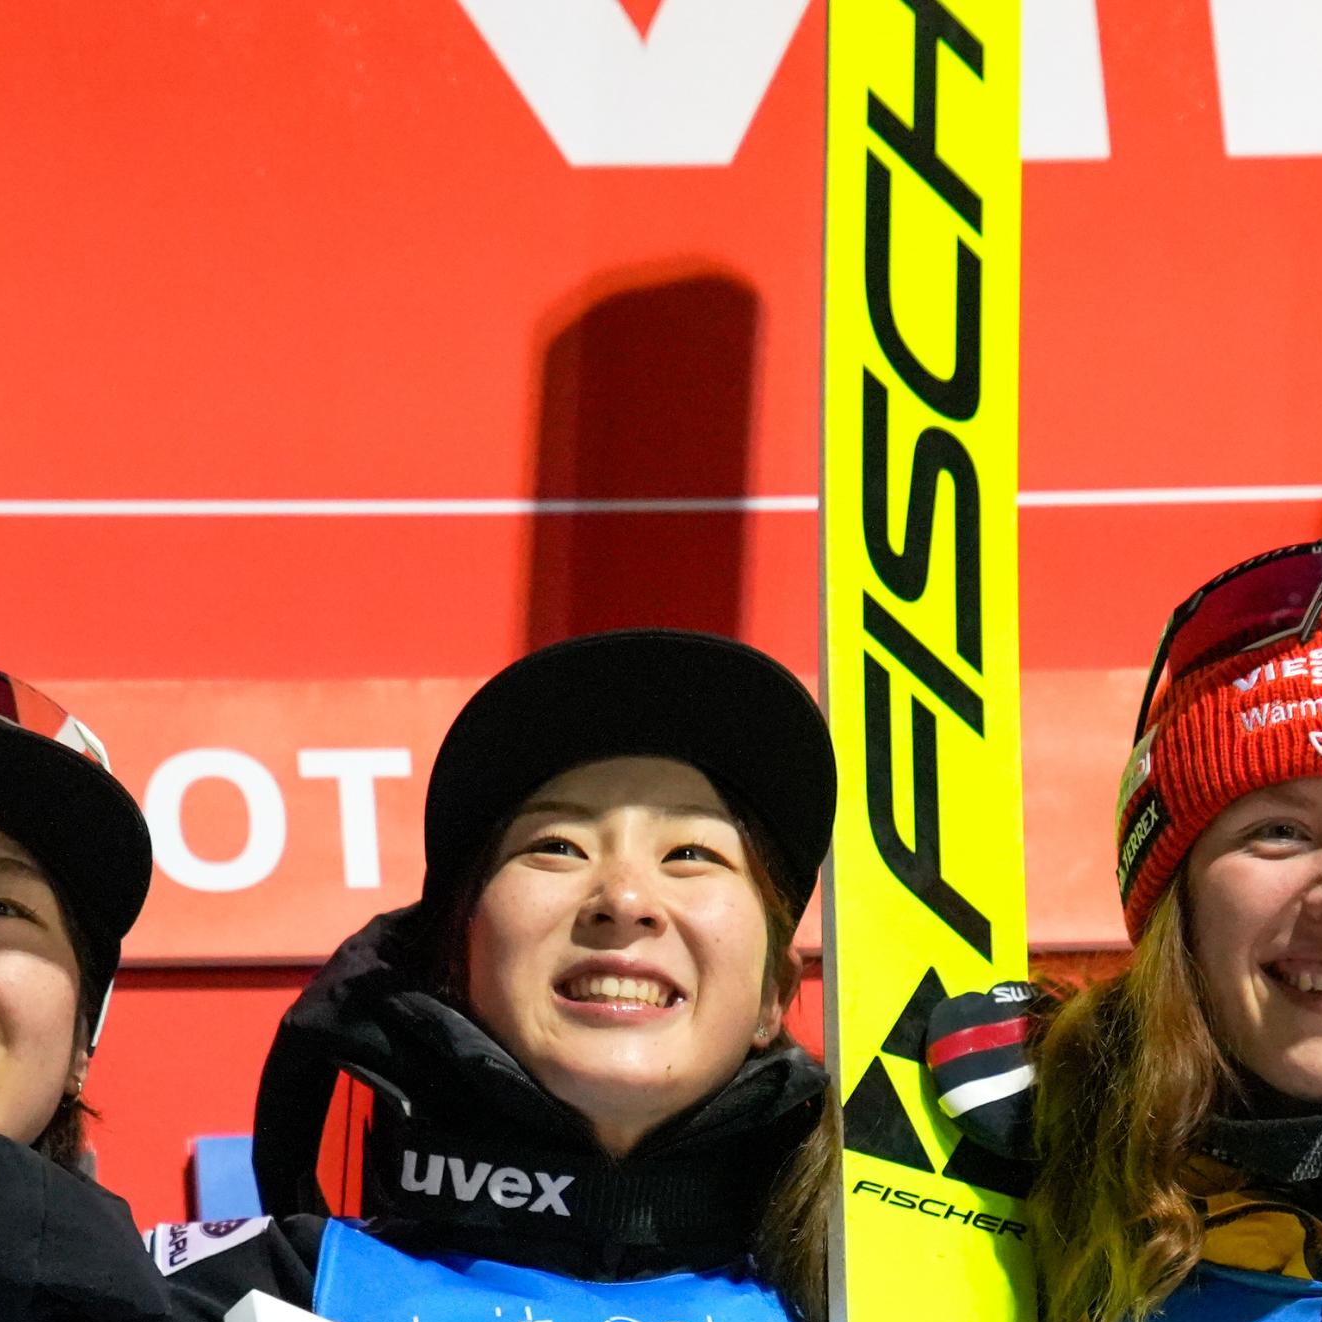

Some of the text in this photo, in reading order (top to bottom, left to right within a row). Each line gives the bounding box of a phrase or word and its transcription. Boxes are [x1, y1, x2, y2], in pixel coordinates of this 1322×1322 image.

[1122, 800, 1159, 872] TERREX
[400, 1149, 575, 1217] uvex
[852, 1179, 1028, 1241] FISCHER
